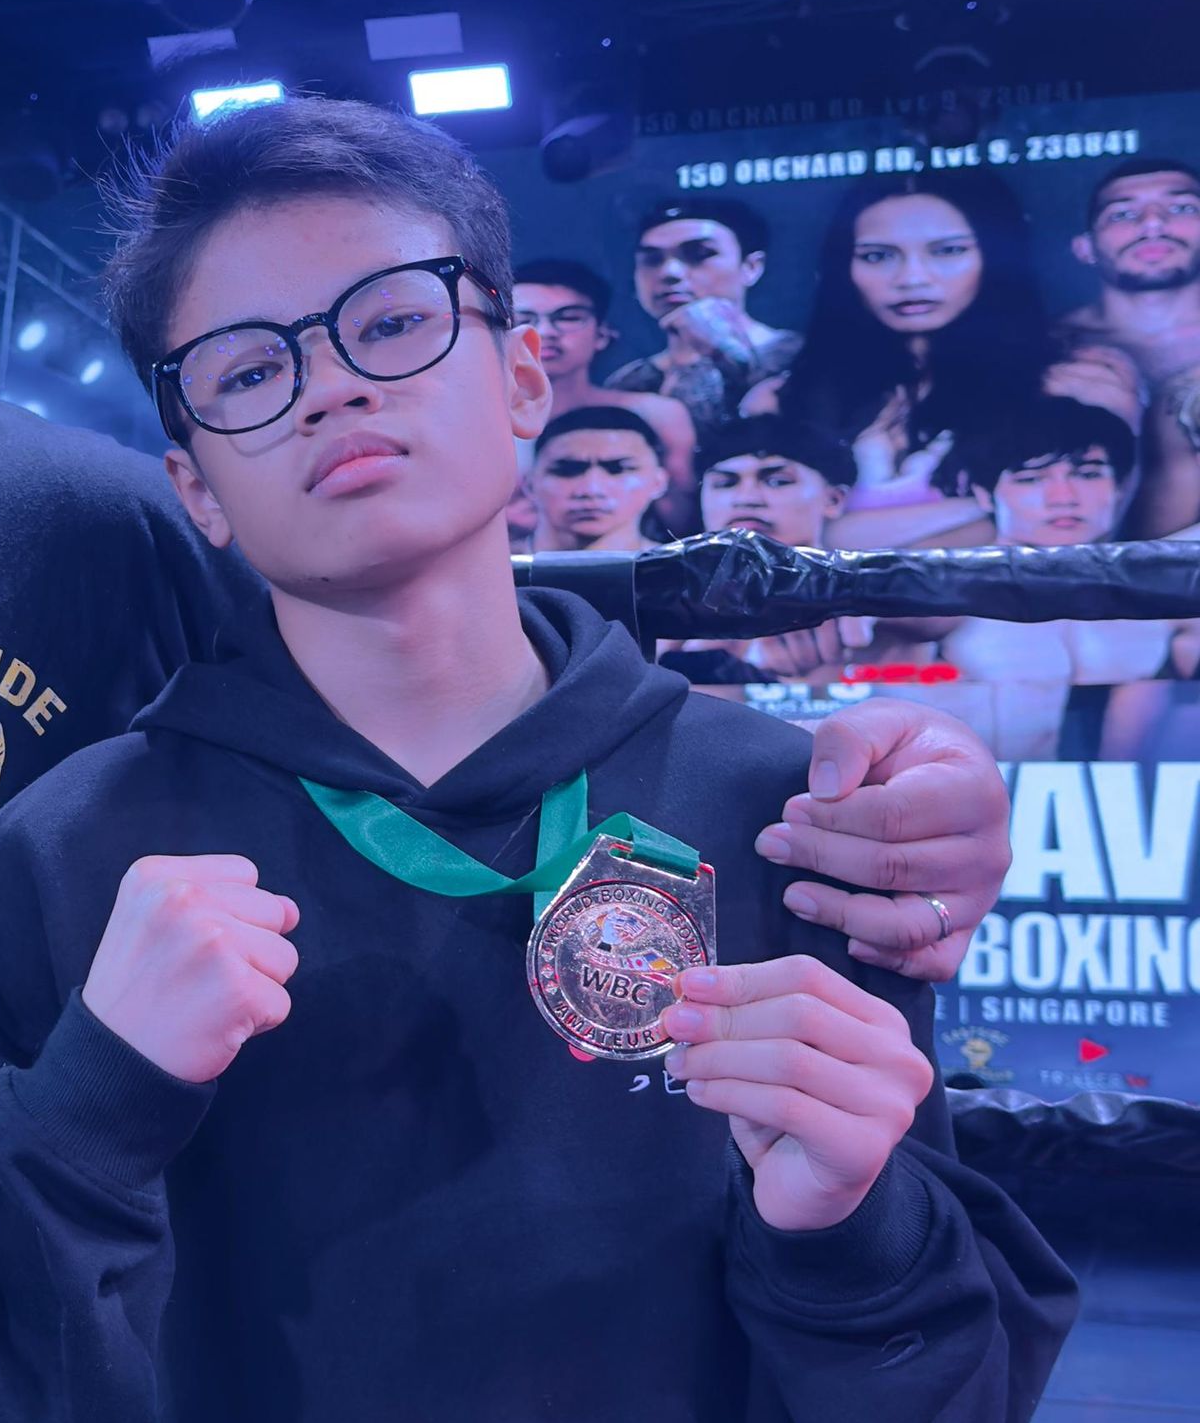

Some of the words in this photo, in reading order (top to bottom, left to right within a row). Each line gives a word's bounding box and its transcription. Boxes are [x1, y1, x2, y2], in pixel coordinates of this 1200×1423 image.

[676, 162, 725, 189] 150
[734, 150, 867, 184] ORCHARD
[875, 145, 924, 173] RD,
[988, 139, 1019, 164] 9,
[997, 761, 1200, 902] AV
[545, 895, 593, 946] WORLD
[601, 889, 667, 913] BOXING
[671, 913, 701, 965] COUN
[959, 911, 1200, 994] BOXIN
[581, 963, 651, 1006] WBC
[555, 1000, 655, 1048] AMATEUR
[981, 996, 1170, 1027] SINGAPORE
